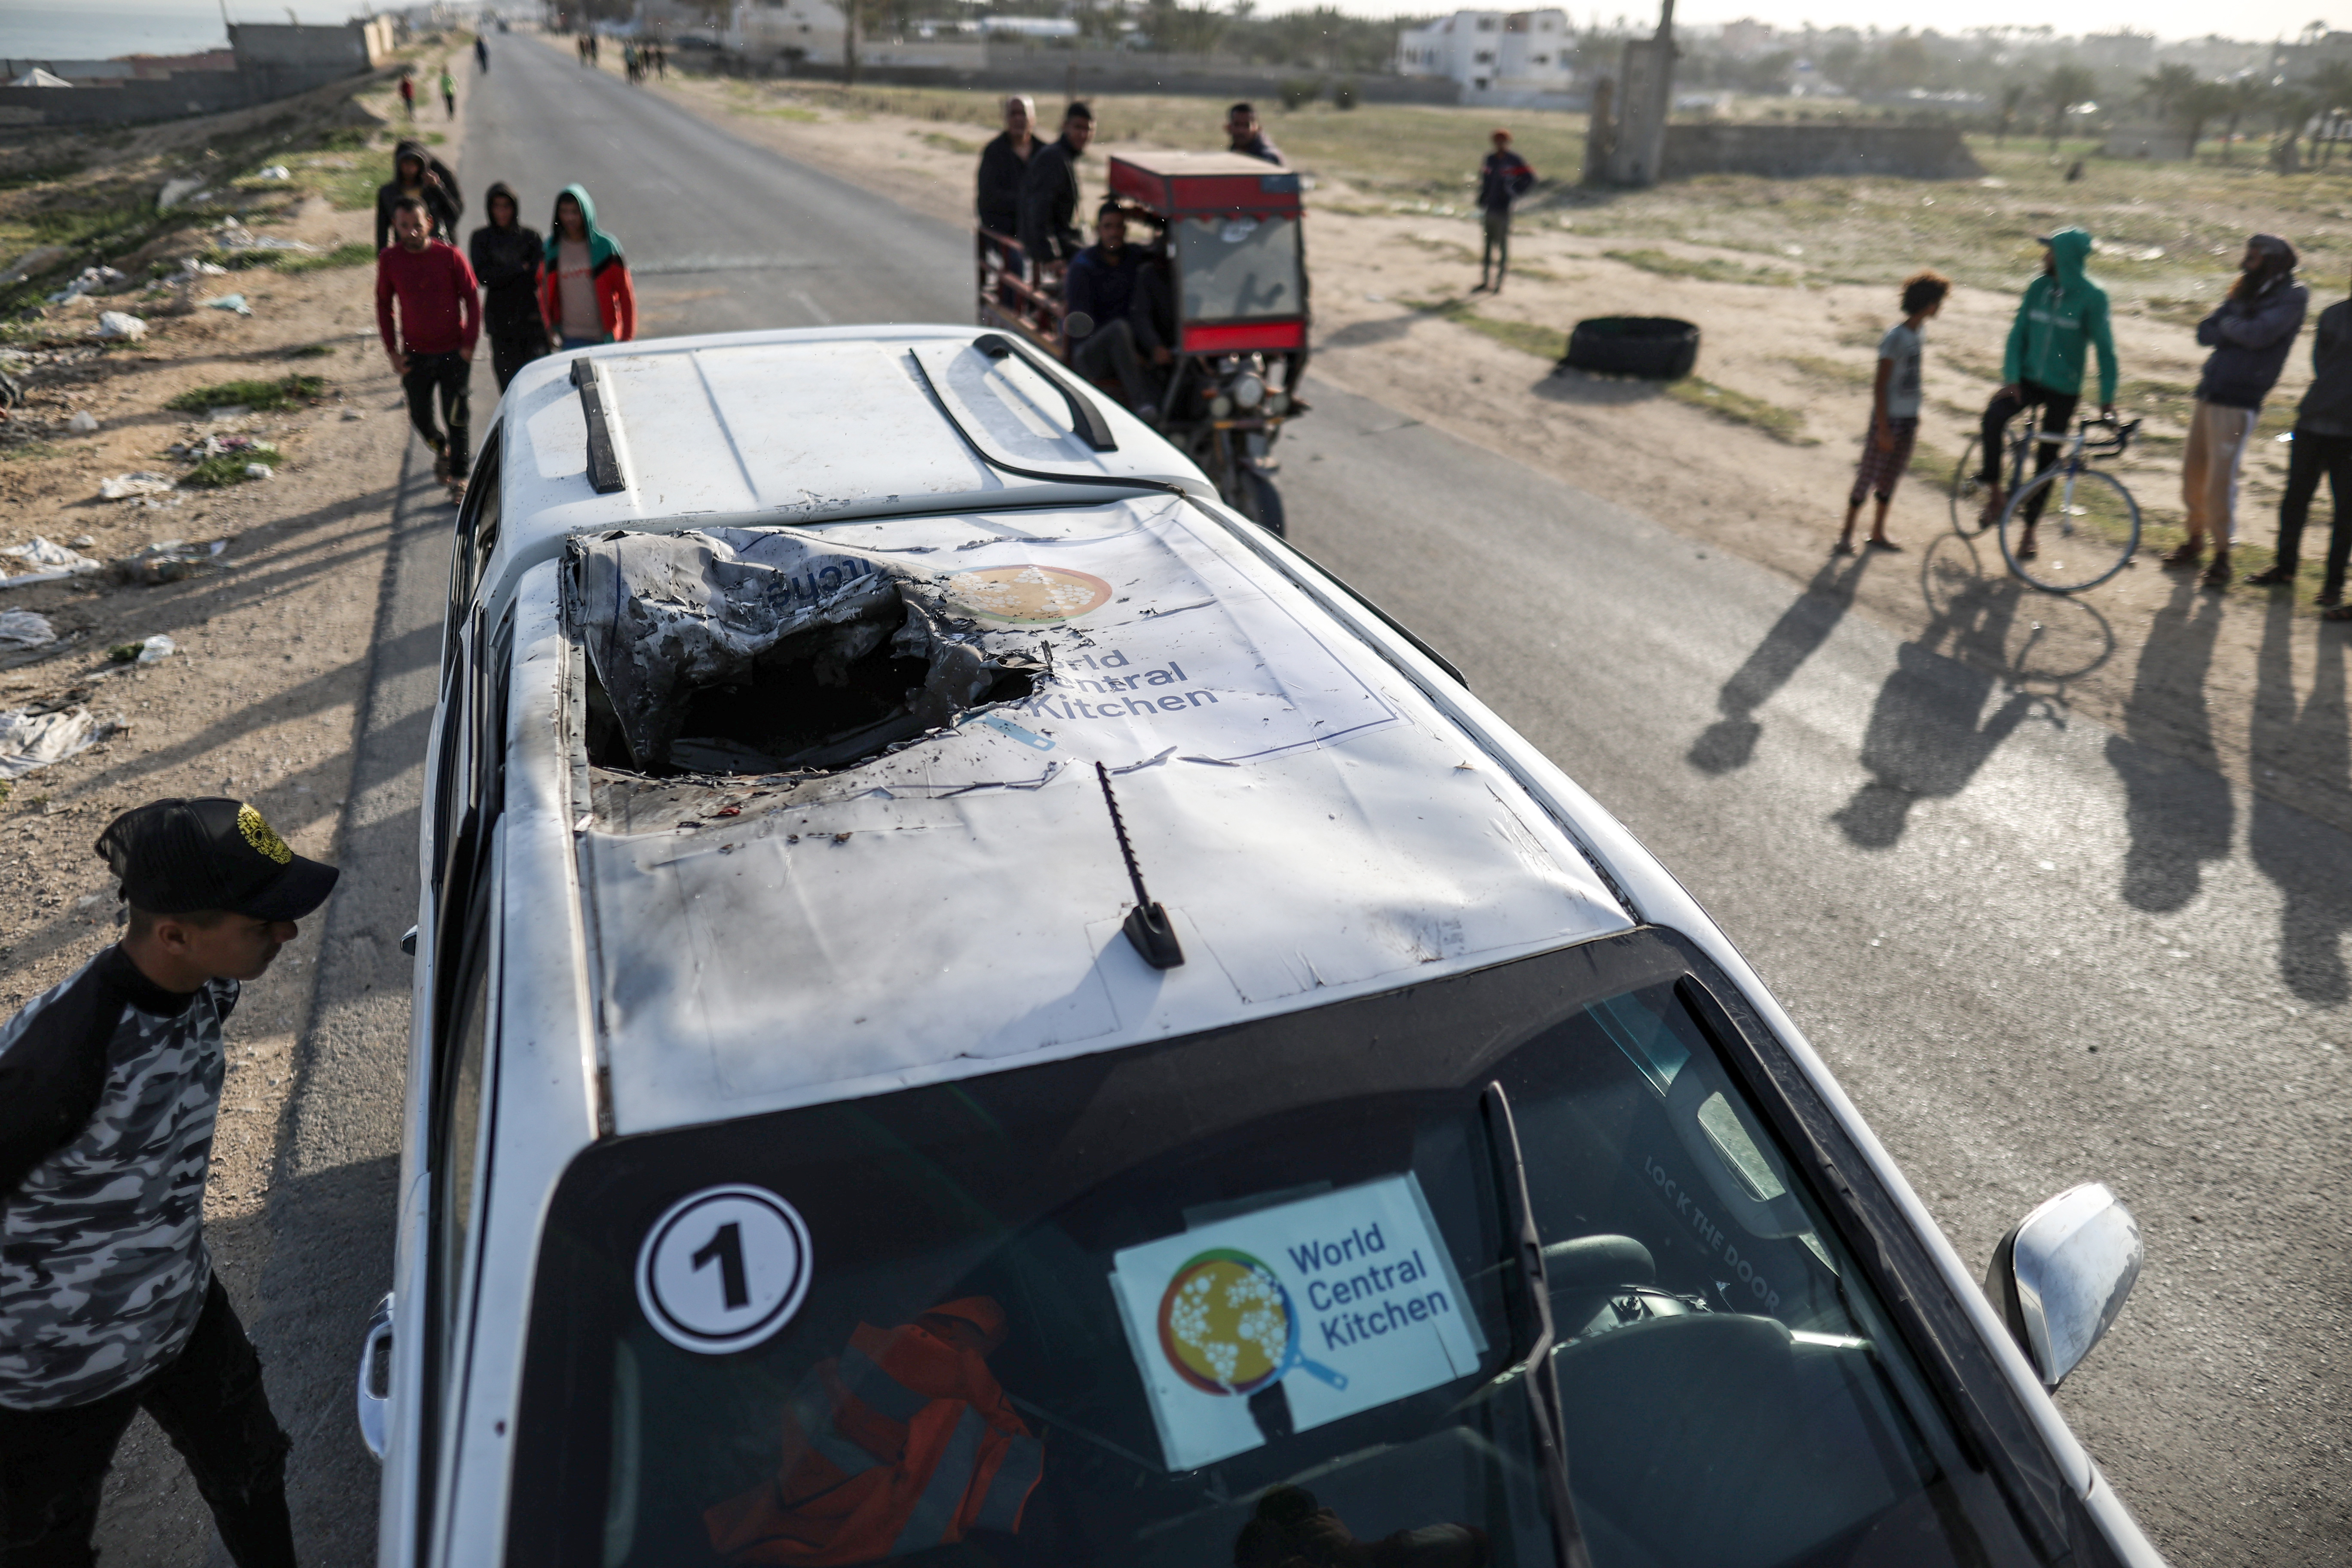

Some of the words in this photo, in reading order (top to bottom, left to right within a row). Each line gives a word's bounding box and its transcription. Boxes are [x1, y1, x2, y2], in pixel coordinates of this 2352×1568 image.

[1028, 690, 1219, 719] Kitchen
[1052, 661, 1188, 693] entral
[691, 1222, 750, 1311] 1
[1288, 1223, 1385, 1274] World
[1693, 1207, 1724, 1252] THE
[1724, 1244, 1779, 1315] DOOR
[1308, 1250, 1427, 1311] Central
[1320, 1291, 1449, 1351] Kitchen
